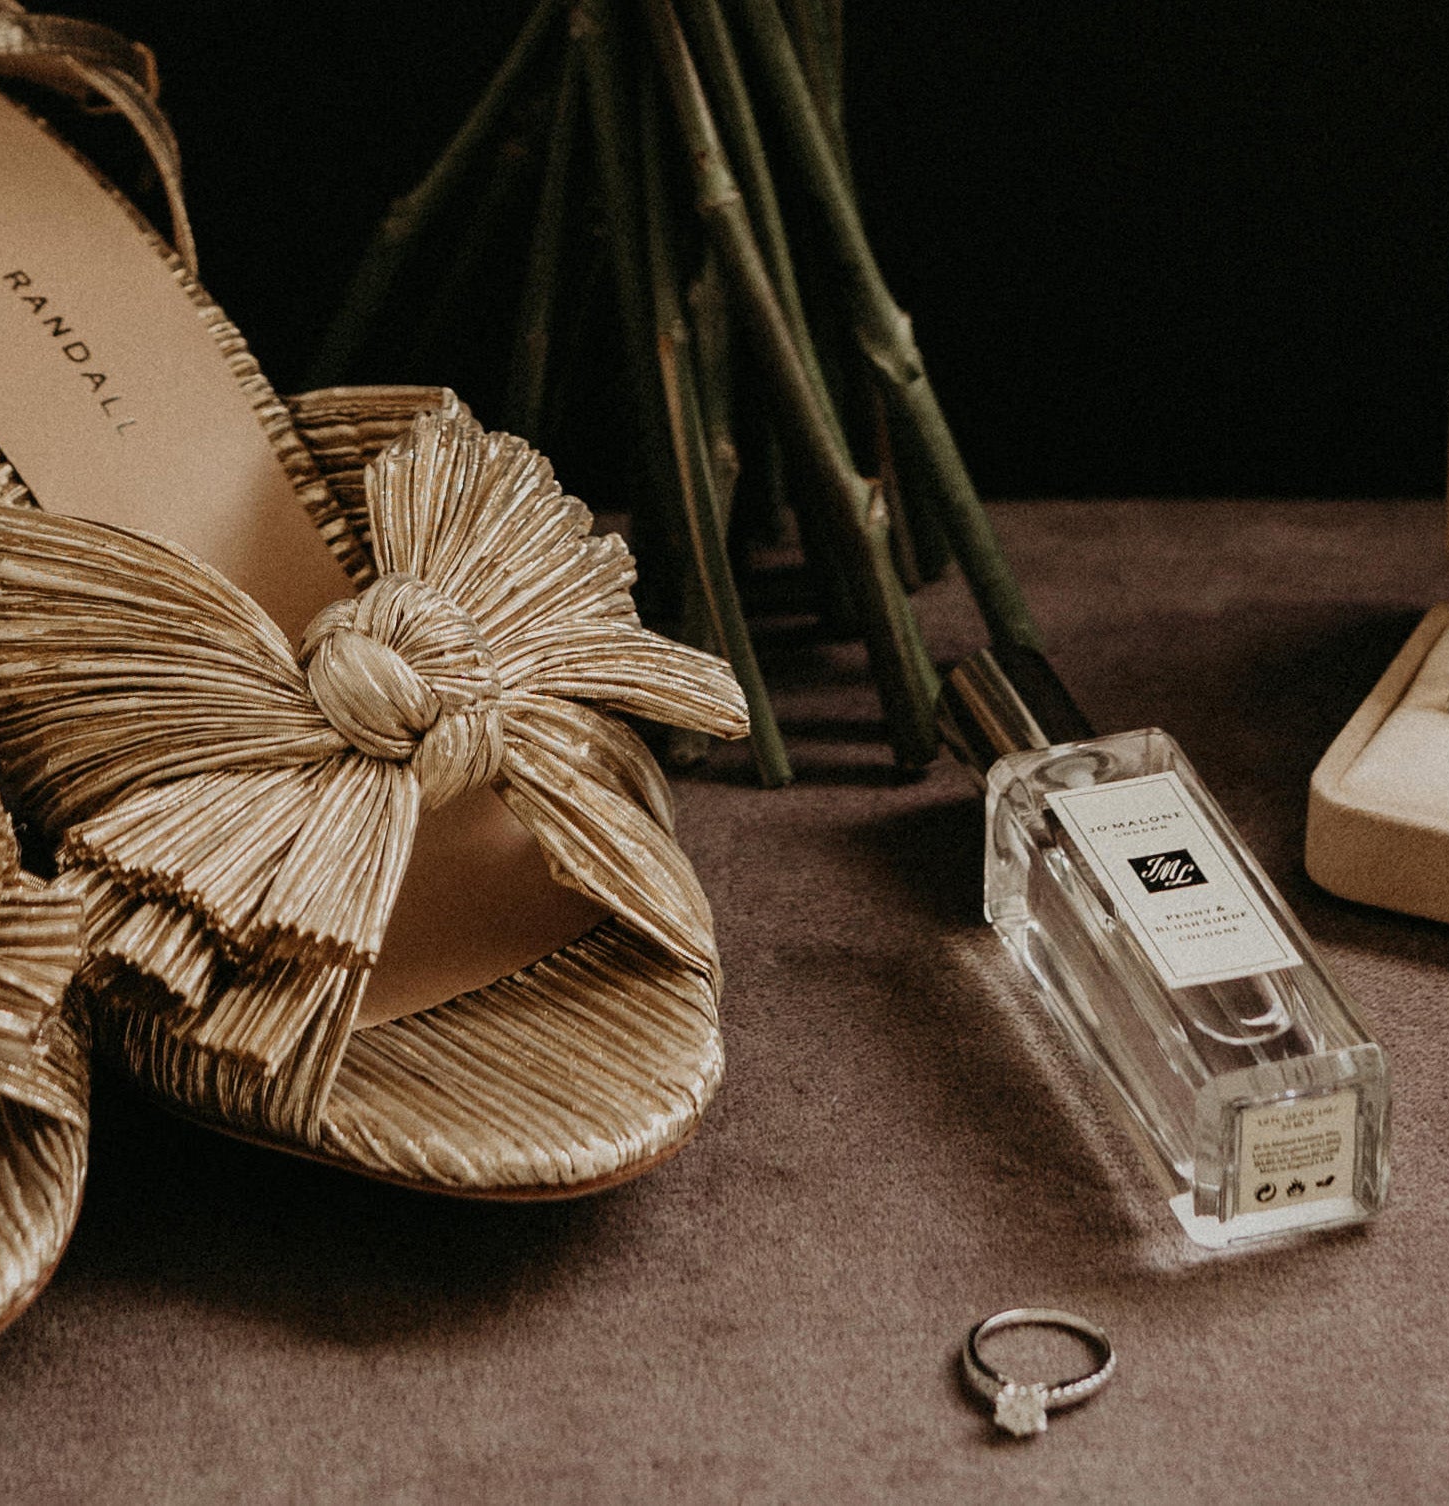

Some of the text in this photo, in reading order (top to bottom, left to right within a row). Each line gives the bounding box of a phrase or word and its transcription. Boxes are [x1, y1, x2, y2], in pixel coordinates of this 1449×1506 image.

[3, 269, 137, 437] RANDALL
[1088, 811, 1184, 834] JO MALONE
[1155, 911, 1248, 934] BLUSH SUEDE
[1164, 905, 1226, 922] PEONY &
[1178, 925, 1241, 942] COLOGNE
